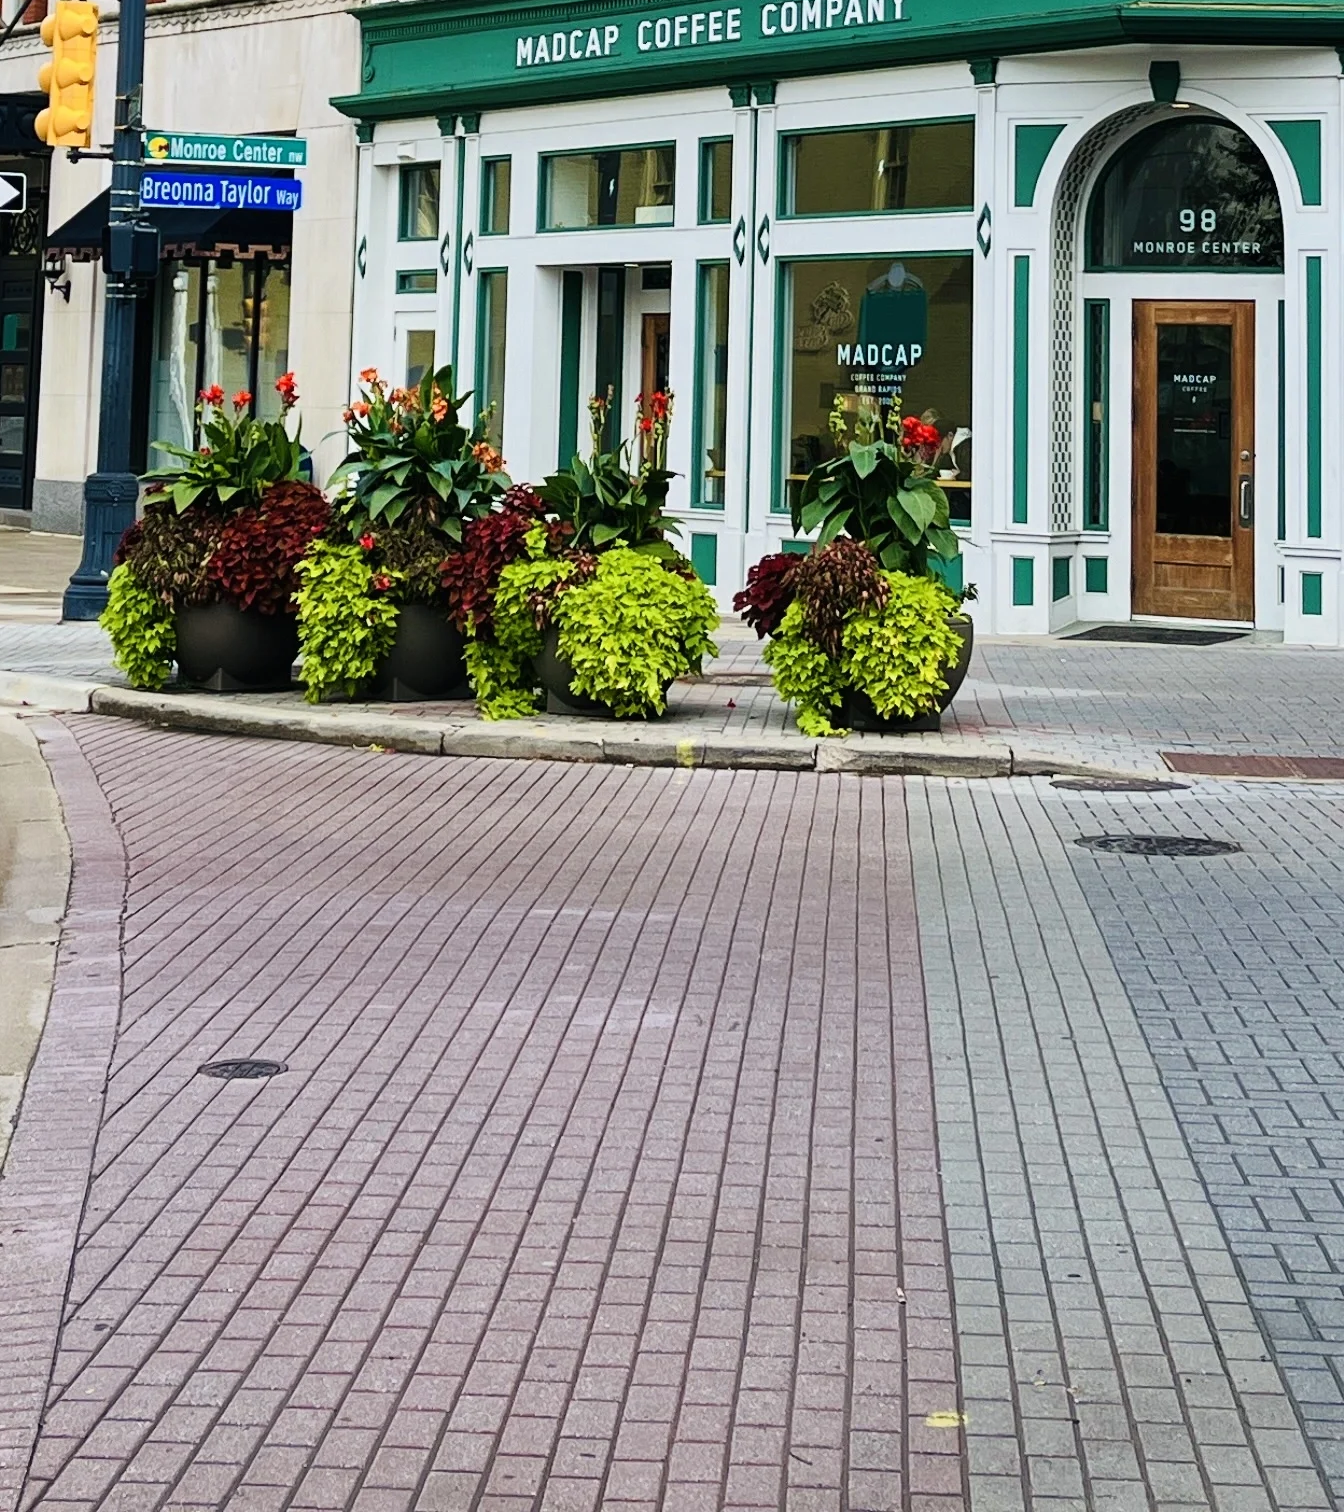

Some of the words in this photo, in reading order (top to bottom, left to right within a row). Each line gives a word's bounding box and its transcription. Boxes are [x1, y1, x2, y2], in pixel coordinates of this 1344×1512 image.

[516, 25, 620, 67] MADCAP
[637, 7, 742, 51] COFFEE
[171, 137, 226, 160] Monroe
[233, 139, 283, 163] Center
[143, 177, 213, 202] Breonna
[219, 180, 272, 209] Taylor
[276, 189, 299, 210] Way
[1179, 208, 1217, 233] 98
[1133, 241, 1195, 254] MONROE
[1202, 241, 1261, 254] CENTER
[837, 343, 922, 366] MADCAP
[876, 373, 907, 382] COMPANY
[1173, 374, 1217, 384] MADCAP
